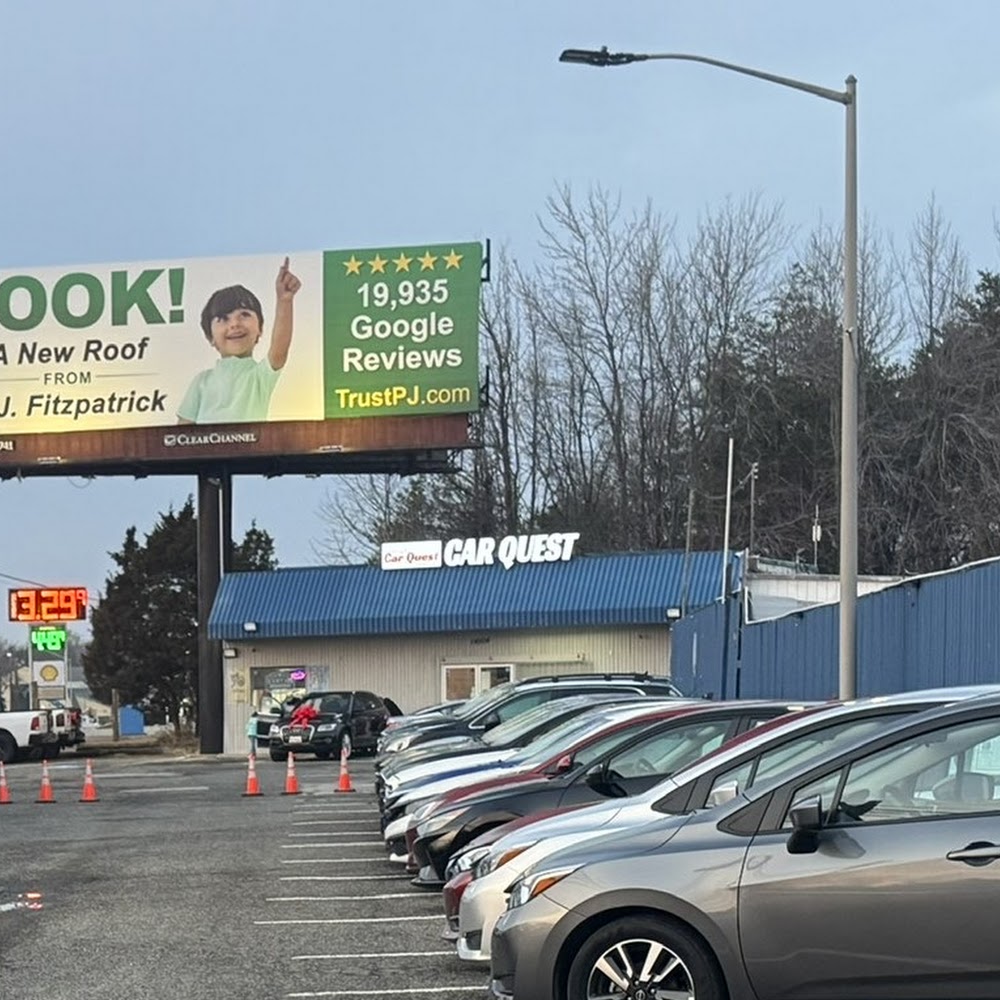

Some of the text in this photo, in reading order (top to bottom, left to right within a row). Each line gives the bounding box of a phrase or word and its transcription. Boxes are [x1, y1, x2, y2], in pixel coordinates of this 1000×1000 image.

[357, 279, 449, 311] 19,935
[351, 312, 454, 342] Google
[17, 341, 75, 366] New
[83, 337, 150, 362] Roof
[343, 346, 463, 372] Reviews
[43, 372, 92, 385] FROM
[27, 389, 167, 420] Fitzpatrick
[335, 385, 470, 409] TrustPJ.com
[384, 551, 439, 564] Car Quest
[443, 532, 580, 570] CAR QUEST
